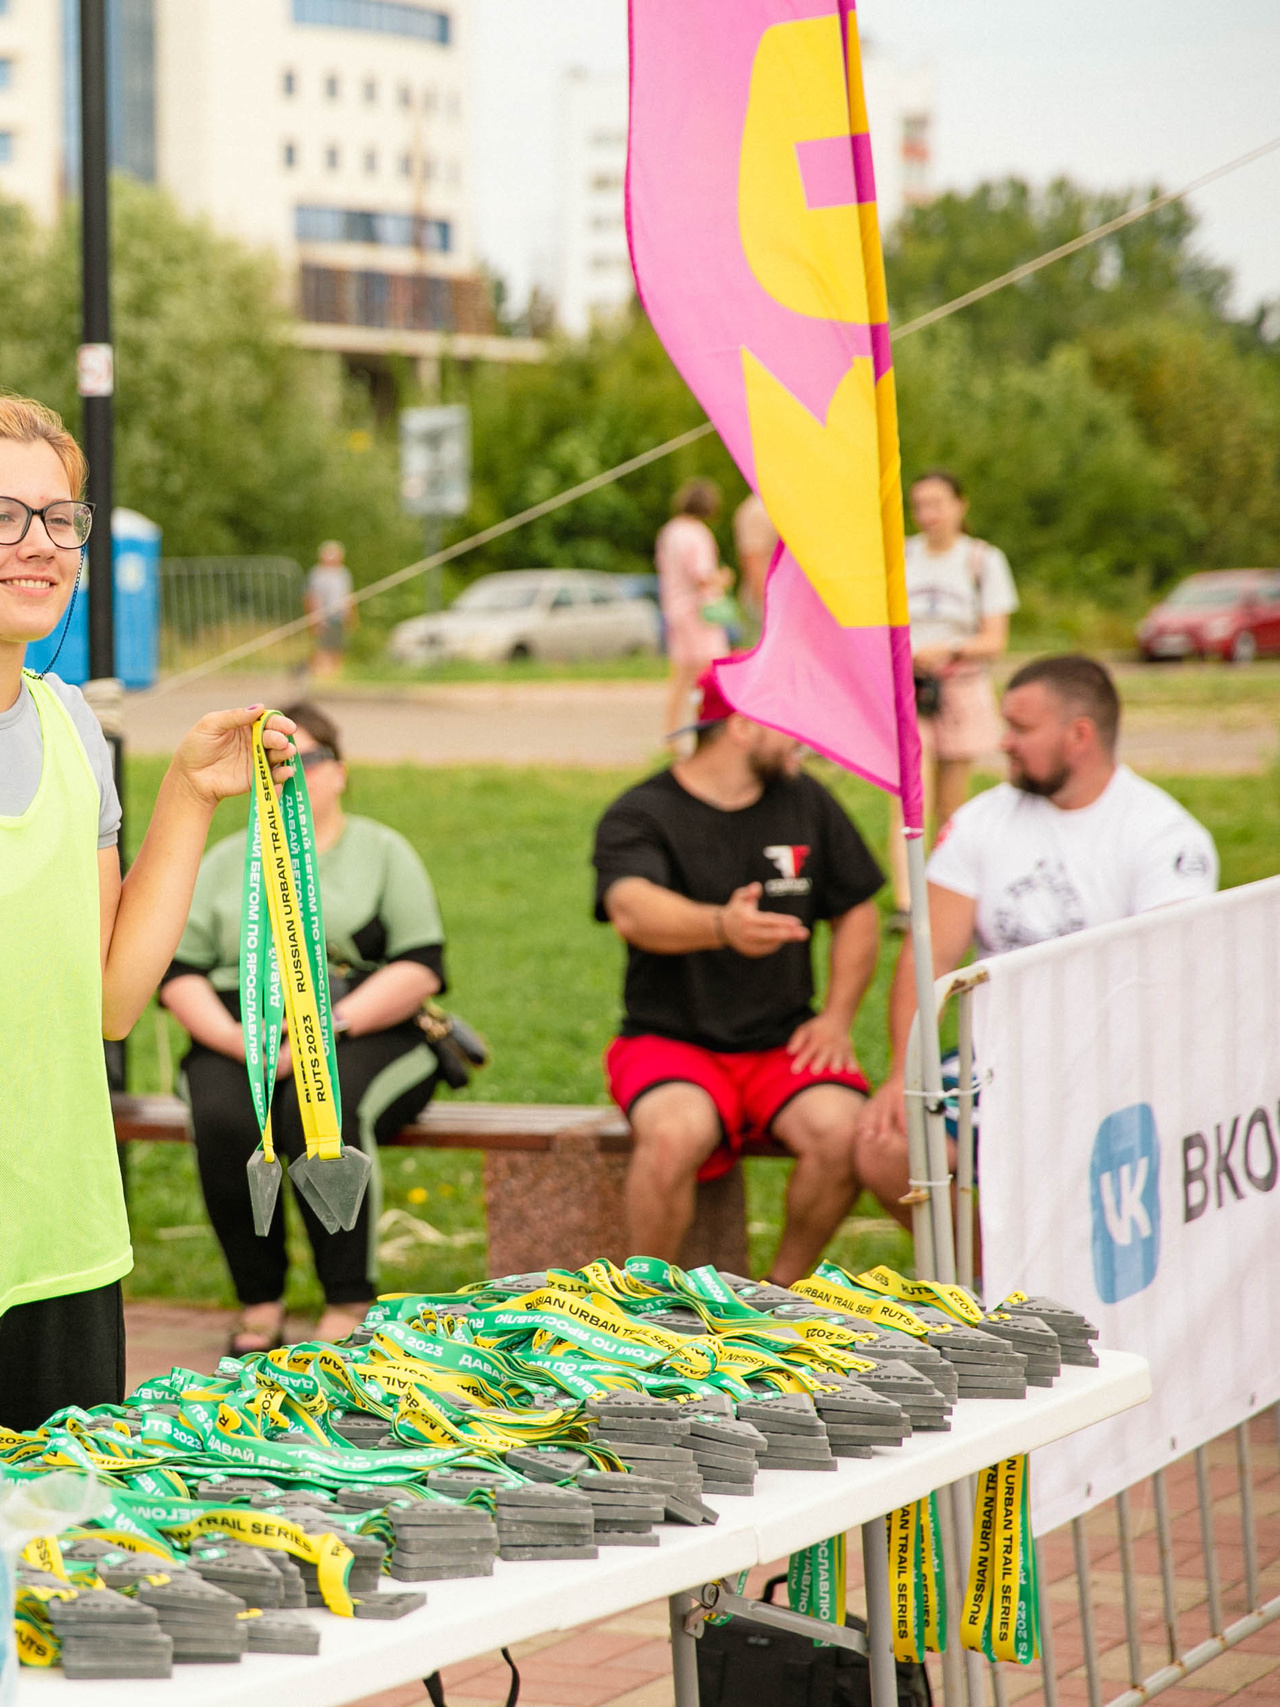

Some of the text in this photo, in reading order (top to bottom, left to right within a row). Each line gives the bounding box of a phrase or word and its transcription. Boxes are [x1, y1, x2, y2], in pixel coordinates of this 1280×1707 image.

[256, 744, 272, 801] SERIES
[267, 805, 282, 853] TRAIL
[247, 861, 261, 920] БЕГОМ
[276, 857, 293, 916] URBAN
[304, 853, 318, 913] БЕГОМ
[247, 924, 259, 949] ПО
[310, 915, 320, 941] ПО
[286, 919, 307, 993] RUSSIAN
[246, 952, 259, 1065] ЯРОСЛАВЛЮ
[302, 1014, 318, 1054] 2023
[310, 1058, 327, 1102] RUTS
[1183, 1098, 1280, 1224] ВКО
[569, 1304, 620, 1334] URBAN
[799, 1286, 832, 1302] URBAN
[833, 1296, 854, 1310] TRAIL
[880, 1306, 915, 1326] RUTS
[405, 1336, 444, 1357] 2023
[591, 1337, 618, 1353] ПО
[726, 1352, 769, 1368] USSIAN
[172, 1428, 203, 1450] 2023
[1004, 1474, 1015, 1531] URBAN
[197, 1516, 246, 1532] TRAIL
[251, 1521, 313, 1553] SERIES
[897, 1533, 909, 1580] TRAIL
[968, 1462, 999, 1626] RUSSIAN URBAN TRA
[1001, 1533, 1013, 1581] TRAIL
[897, 1582, 908, 1640] SERIES
[998, 1584, 1012, 1642] SERIES
